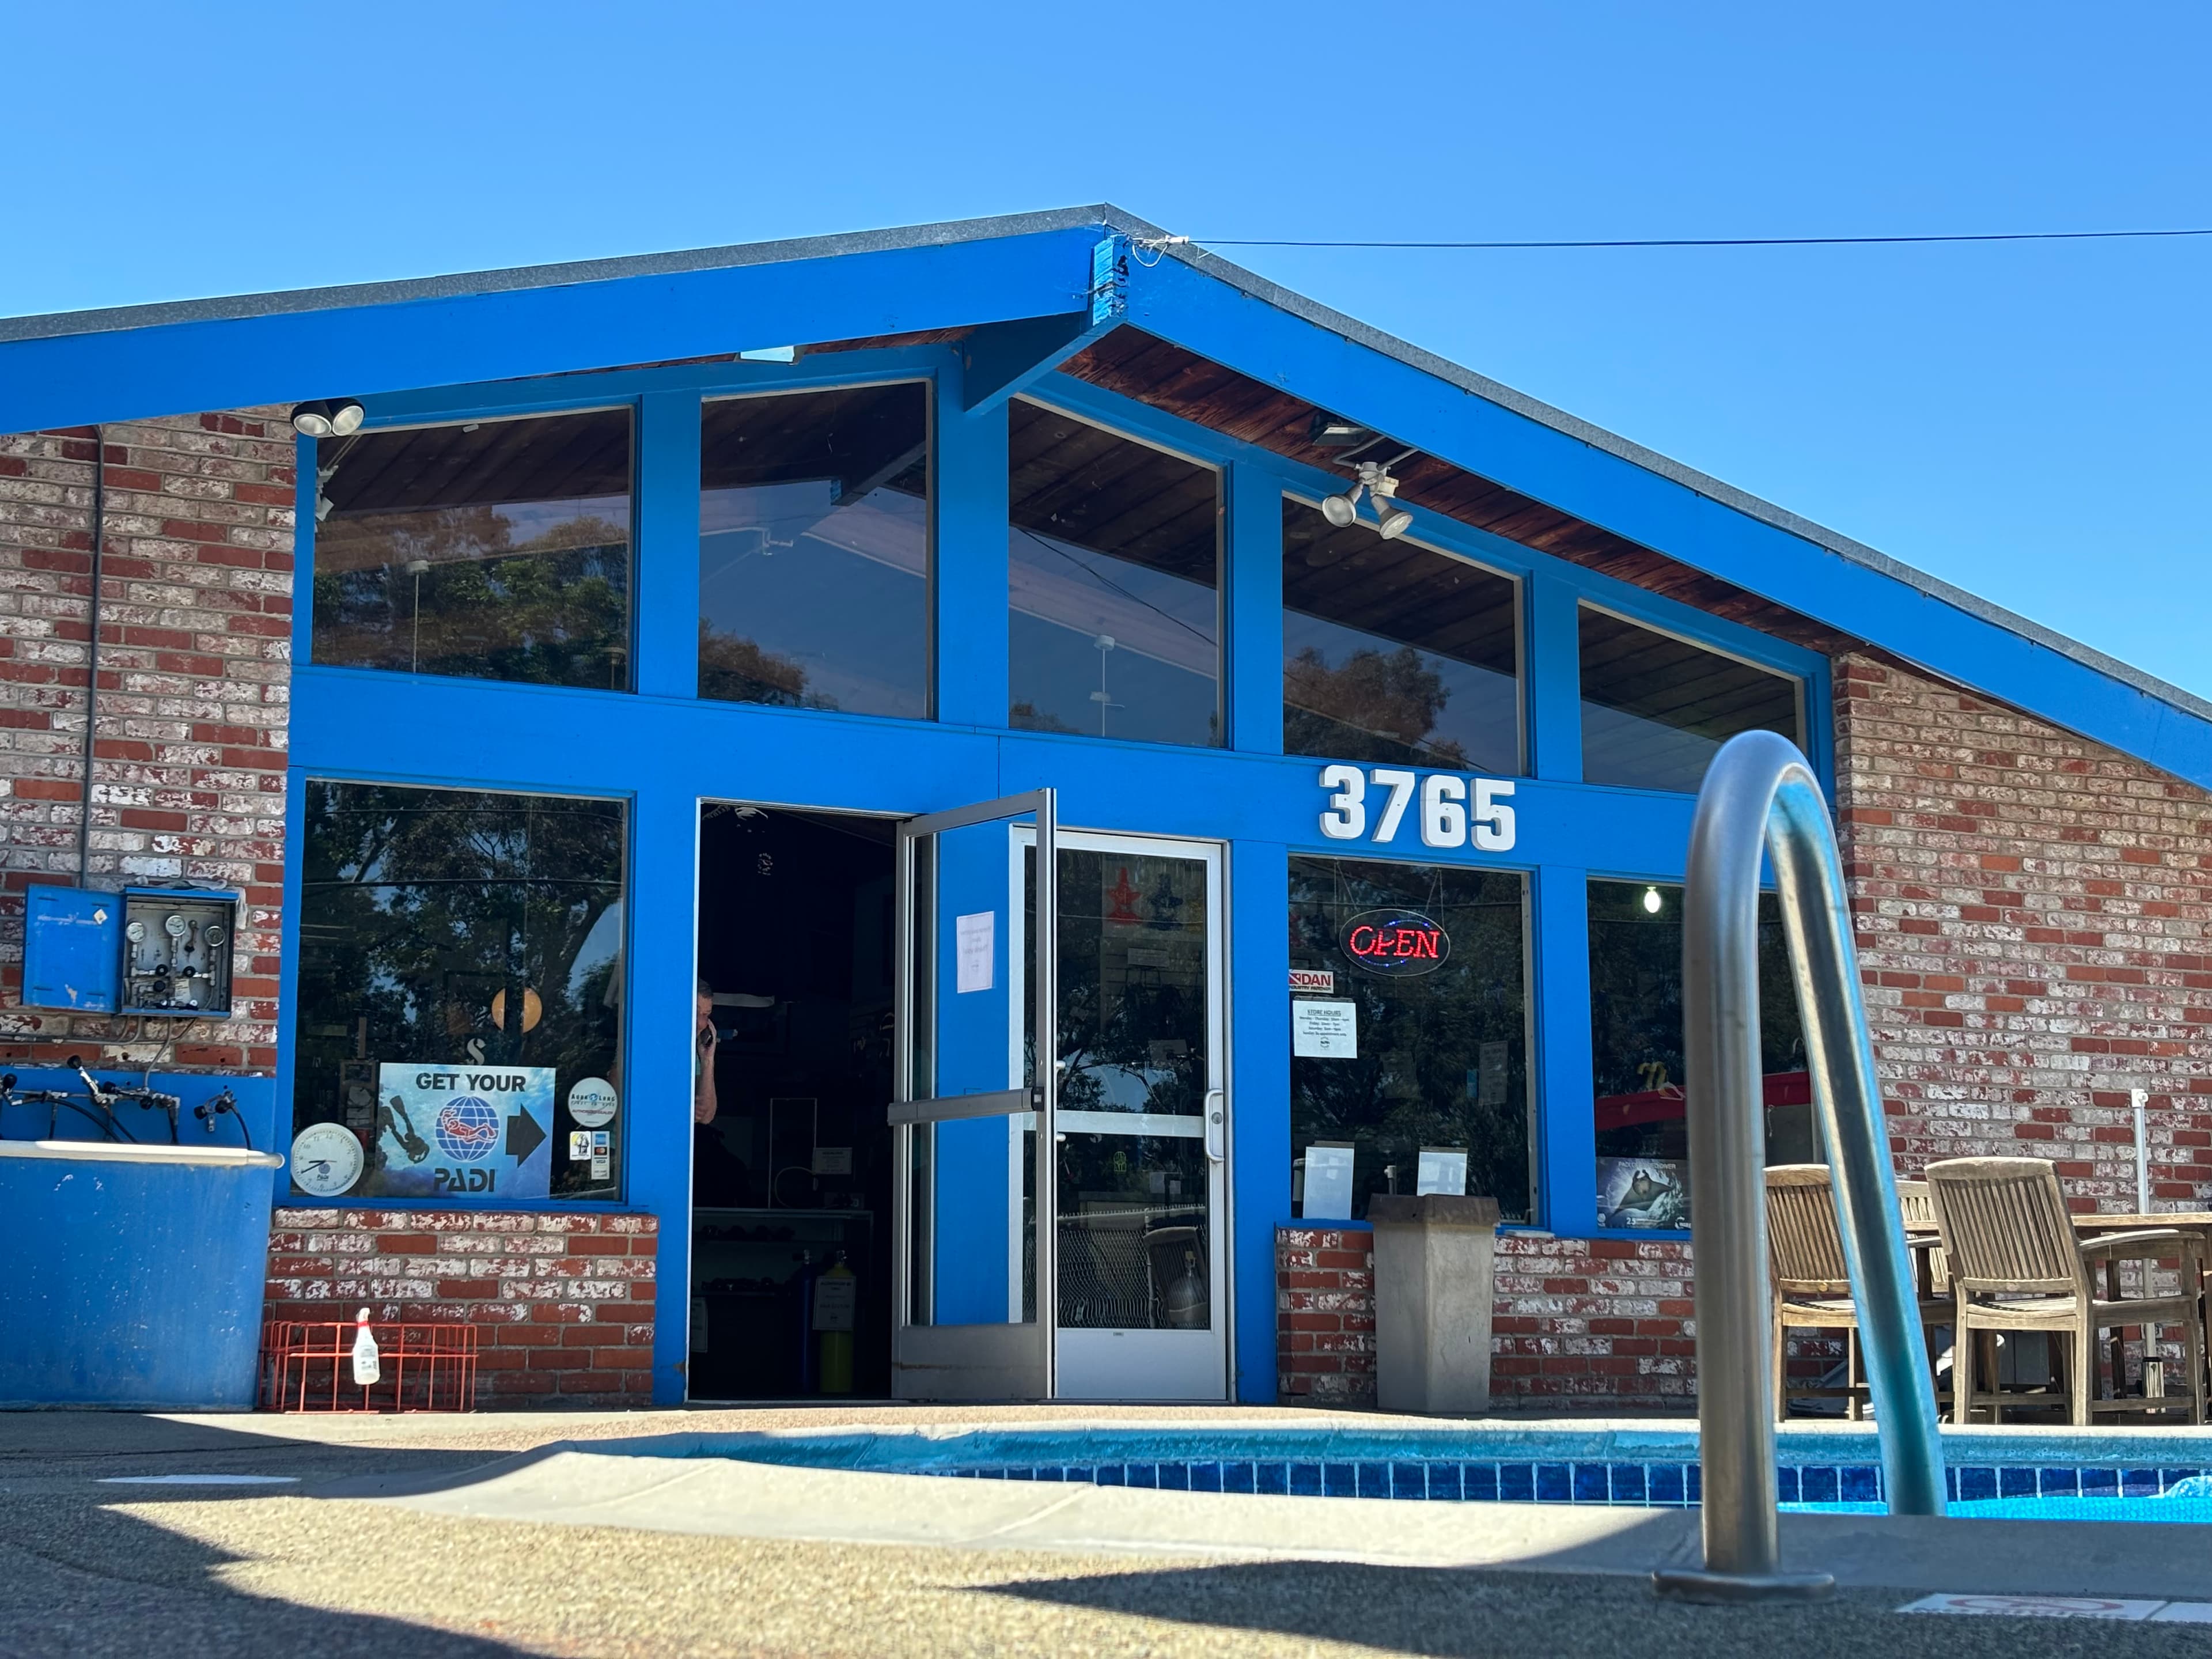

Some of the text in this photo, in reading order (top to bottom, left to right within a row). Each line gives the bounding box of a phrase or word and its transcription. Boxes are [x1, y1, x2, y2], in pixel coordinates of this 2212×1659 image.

[1319, 764, 1516, 851] 3765
[1350, 925, 1440, 959] OPEN
[1302, 974, 1331, 986] DAN
[416, 1073, 526, 1092] GET YOUR
[433, 1168, 495, 1192] PADI
